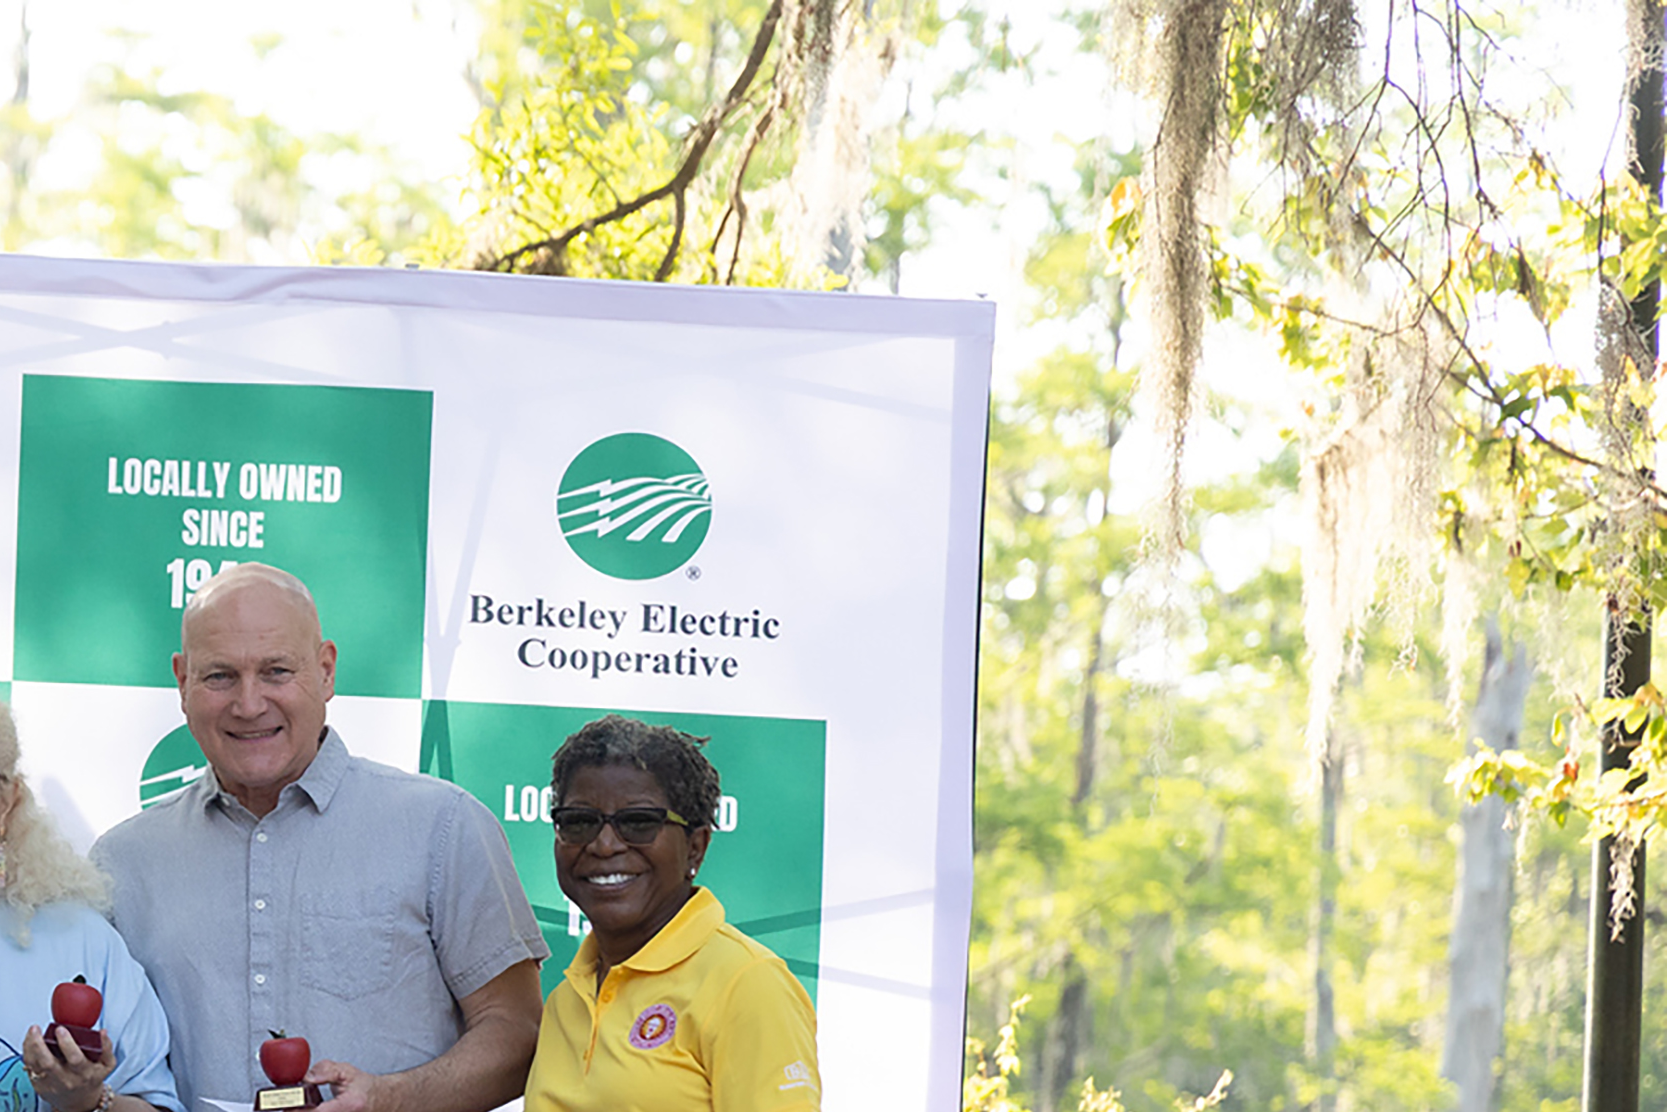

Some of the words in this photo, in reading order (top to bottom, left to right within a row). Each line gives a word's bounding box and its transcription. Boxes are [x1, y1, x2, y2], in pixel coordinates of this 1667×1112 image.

[108, 457, 230, 498] LOCALLY
[239, 463, 342, 503] OWNED
[181, 509, 264, 548] SINCE
[167, 558, 238, 608] 19
[469, 594, 627, 639] Berkeley
[641, 603, 780, 639] Electric
[517, 638, 739, 679] Cooperative
